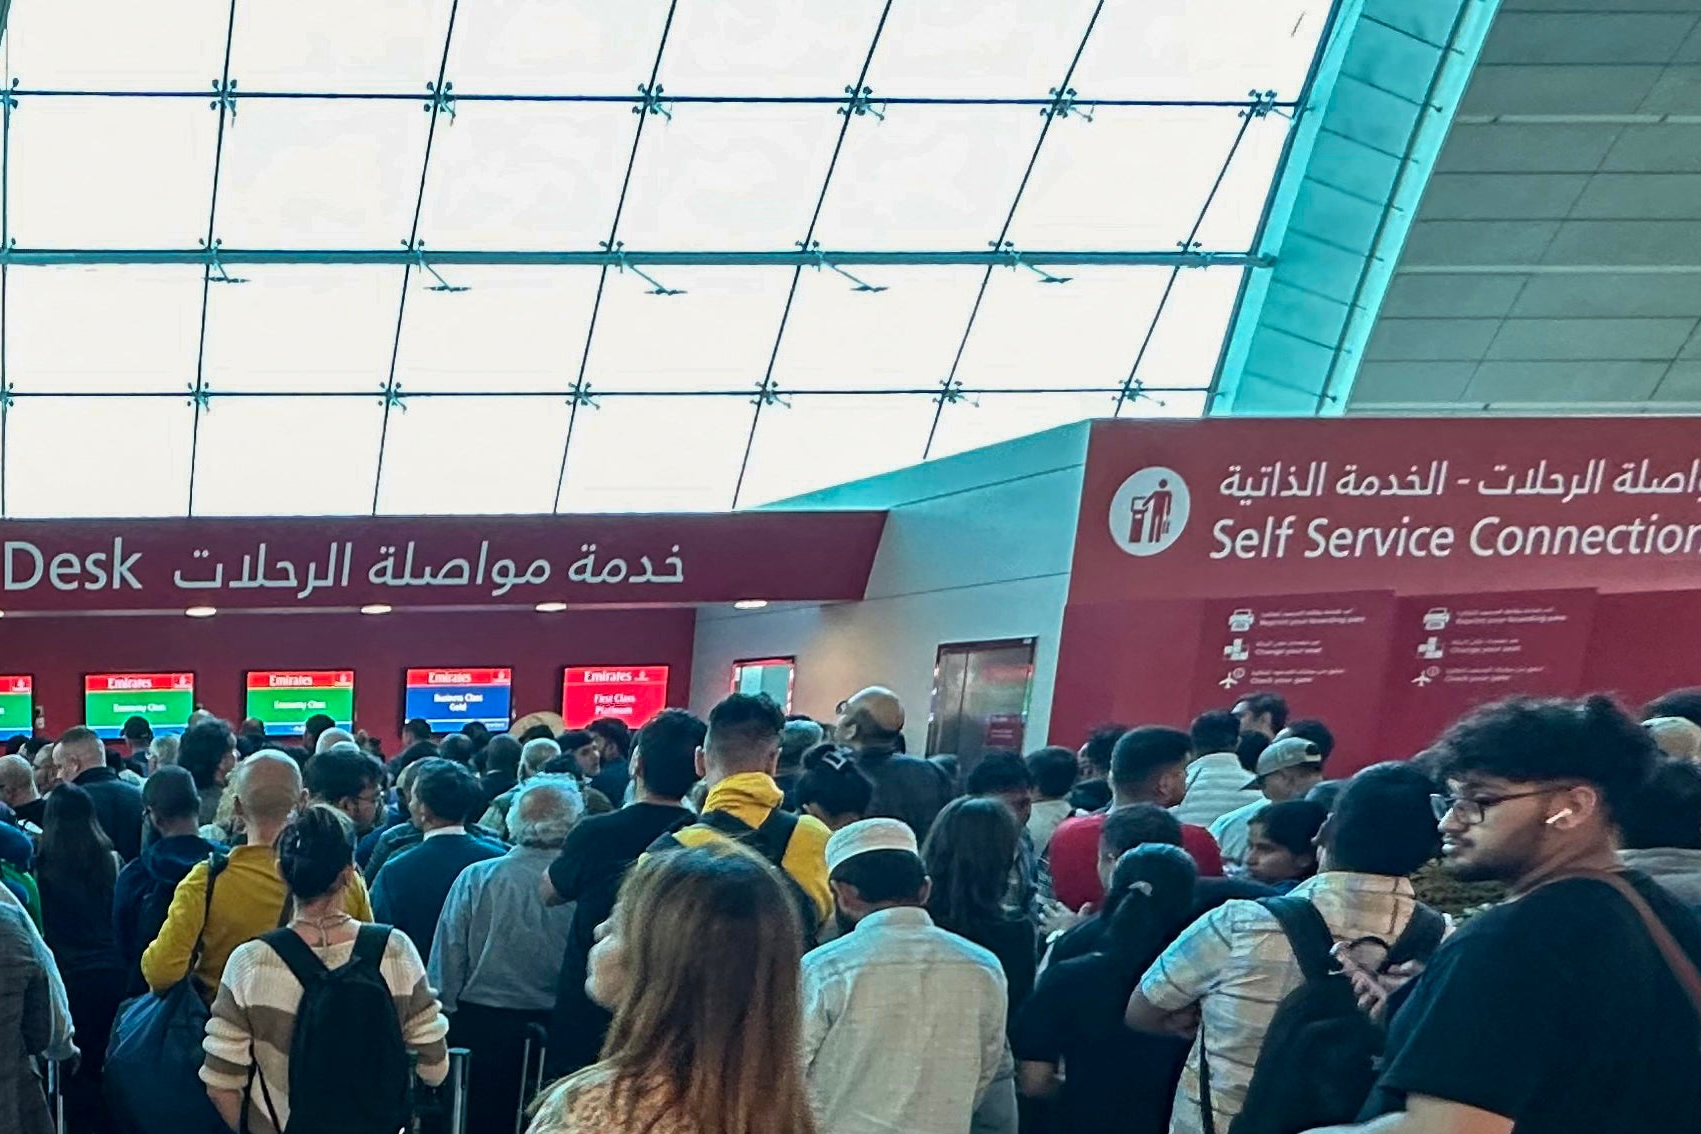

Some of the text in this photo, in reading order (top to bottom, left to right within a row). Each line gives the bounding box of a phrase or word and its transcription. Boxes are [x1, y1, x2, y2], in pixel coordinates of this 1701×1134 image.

[1219, 461, 1327, 506] الذاتية
[1336, 461, 1448, 496] الخدمة
[1478, 458, 1606, 503] الرحلات
[1613, 458, 1701, 502] اصلة
[1209, 515, 1296, 559] Self
[1304, 515, 1455, 558] Service
[3, 536, 143, 591] Desk
[173, 540, 685, 598] خدمة مواصلة الرحلات
[108, 677, 152, 689] Emirates
[269, 675, 313, 686] Emirates
[428, 672, 472, 684] Emirates
[584, 671, 632, 682] Emirates
